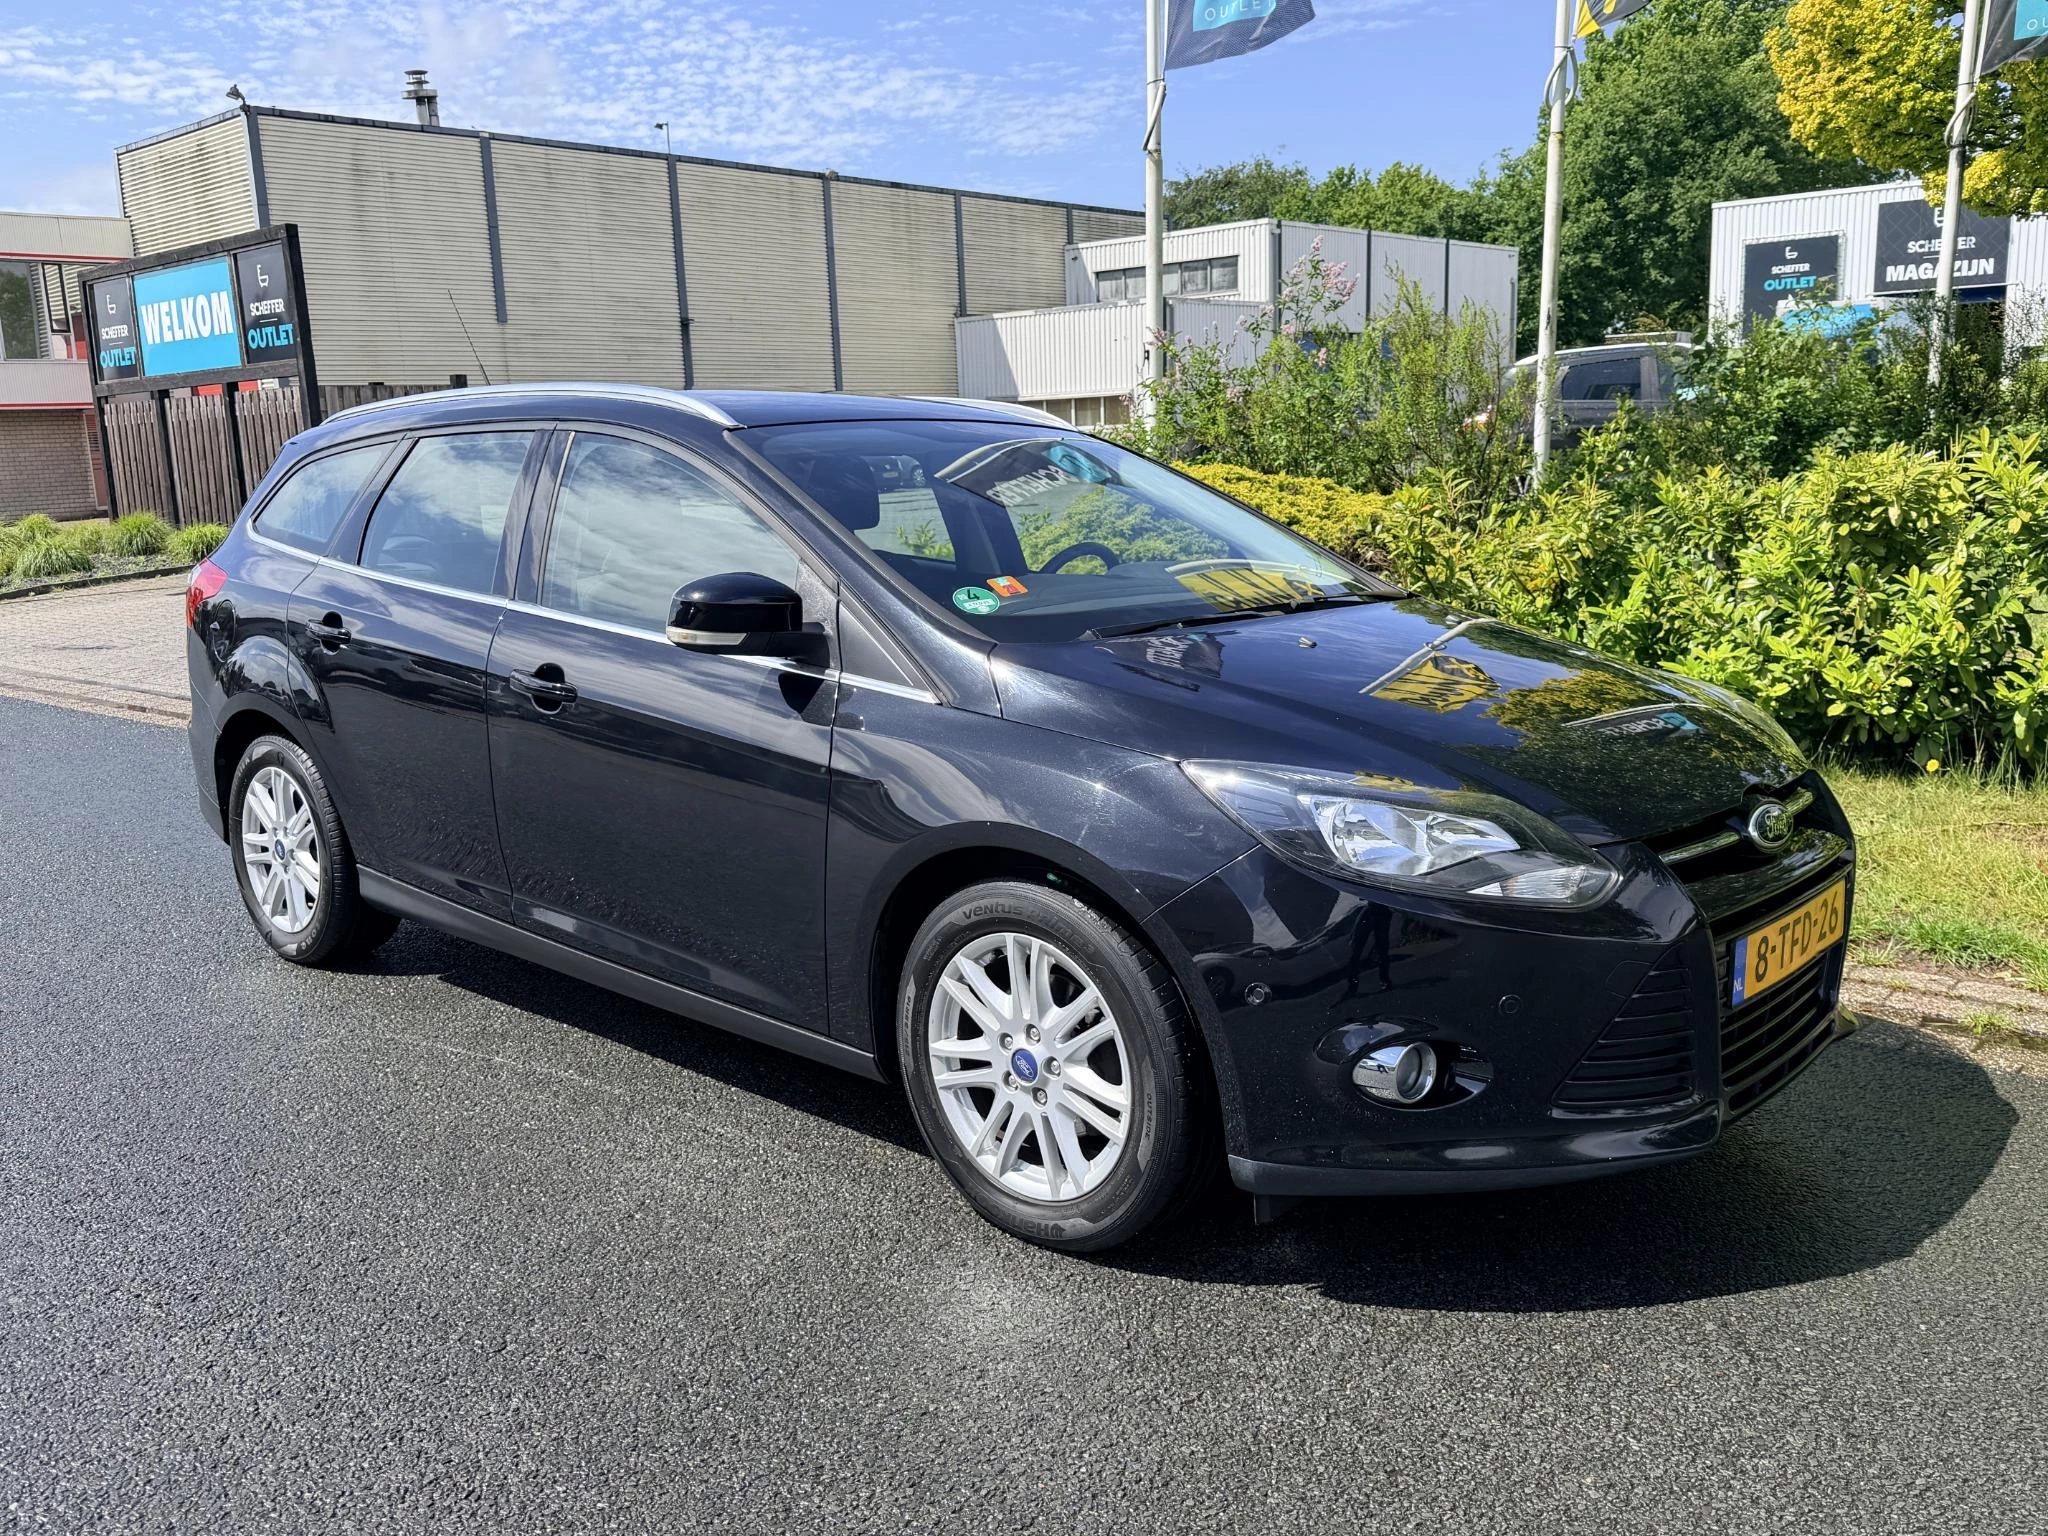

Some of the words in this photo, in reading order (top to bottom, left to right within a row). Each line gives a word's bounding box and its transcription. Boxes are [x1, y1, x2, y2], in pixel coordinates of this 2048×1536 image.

[1907, 236, 1976, 253] SCHEER
[1771, 263, 1810, 274] SCHEFFER
[1764, 276, 1816, 291] OUTLET
[250, 298, 285, 316] SCHEFFER
[141, 291, 233, 344] WELKOM
[101, 324, 129, 340] SCHEFFER
[248, 323, 294, 349] OUTLET
[100, 346, 136, 369] OUTLET
[1755, 890, 1839, 983] 8-TFD-26
[1733, 978, 1743, 993] NL
